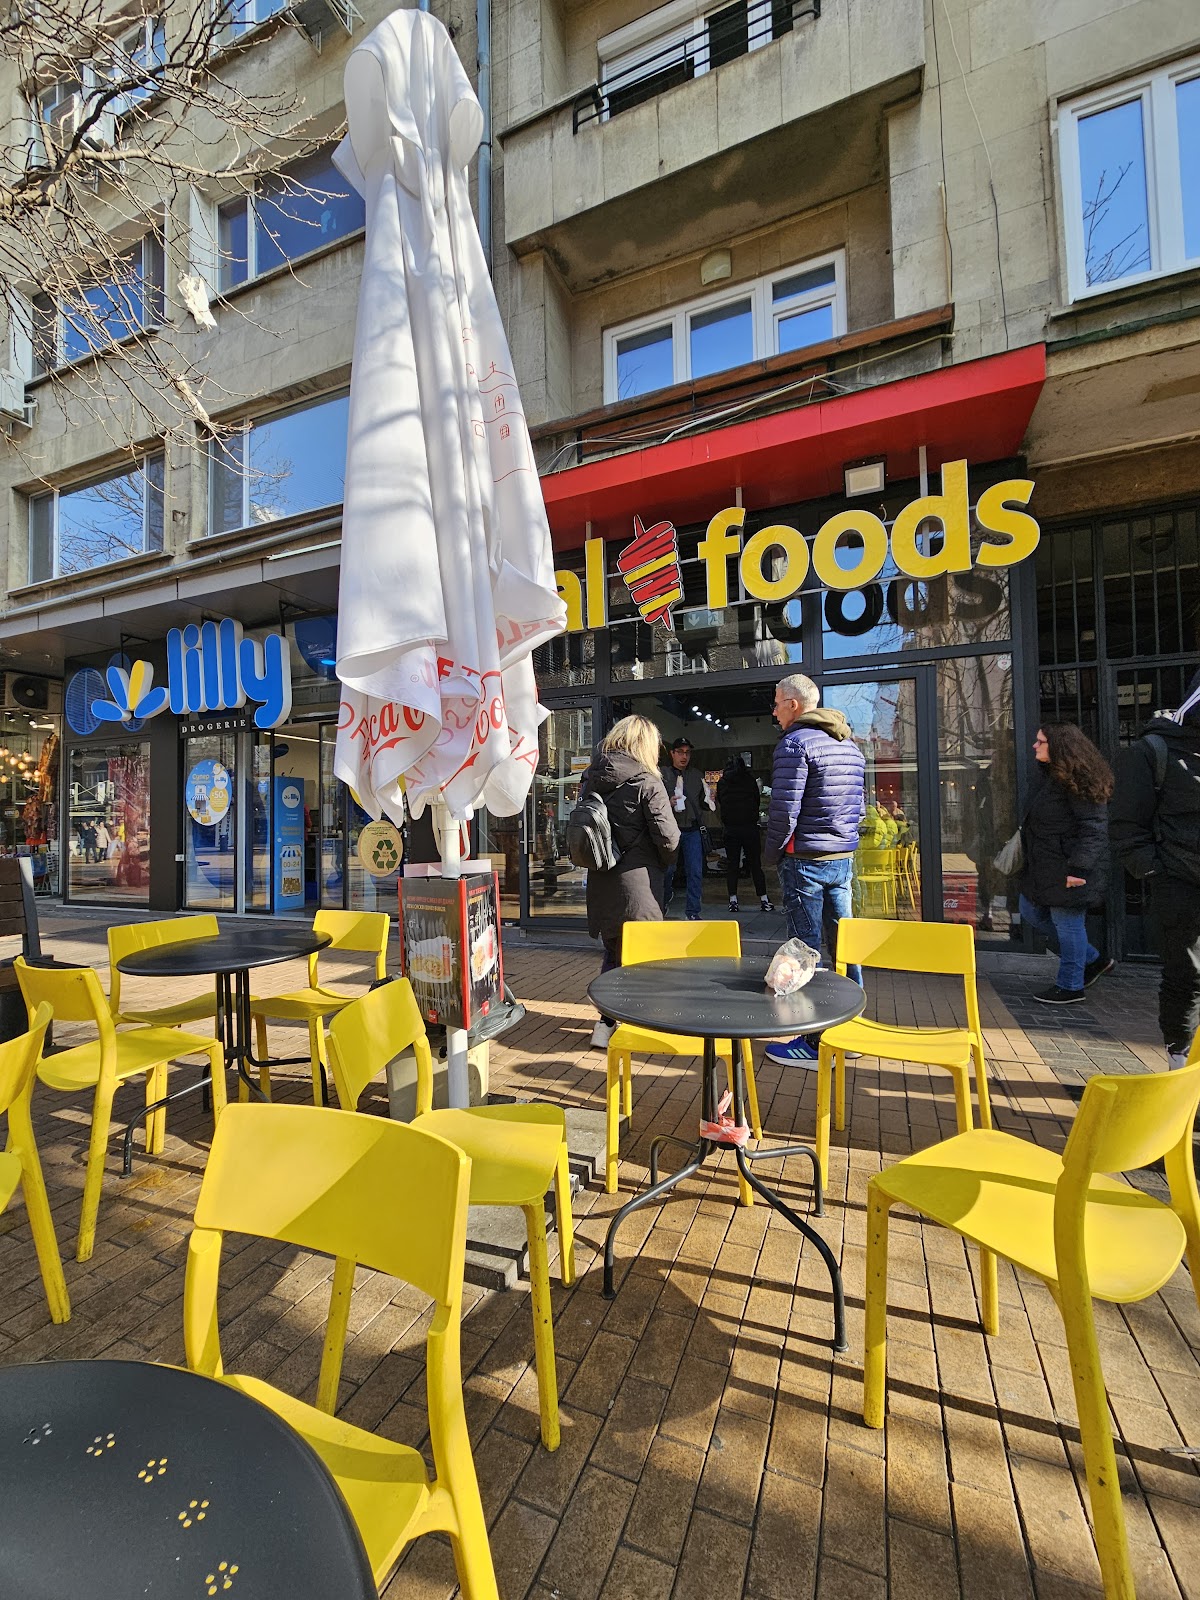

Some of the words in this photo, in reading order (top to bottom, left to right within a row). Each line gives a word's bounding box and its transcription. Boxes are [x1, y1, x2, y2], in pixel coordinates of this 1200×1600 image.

[697, 458, 1041, 610] foods
[167, 617, 289, 729] lilly
[181, 719, 246, 733] DROGERIE
